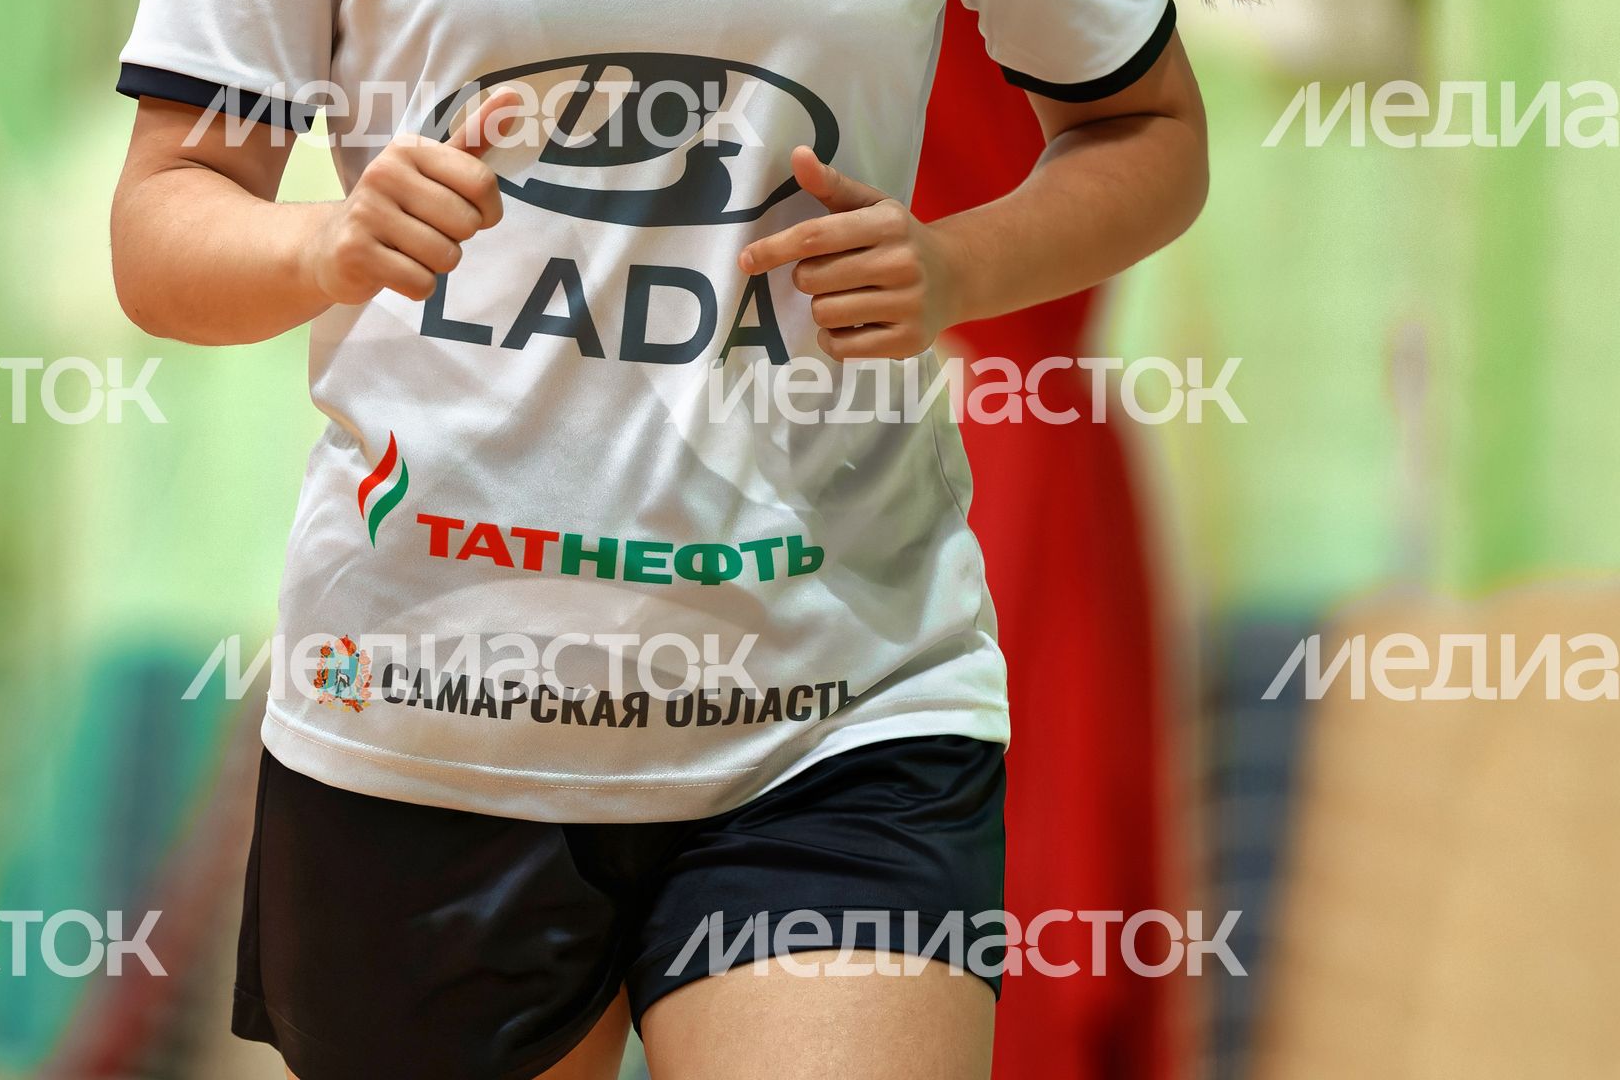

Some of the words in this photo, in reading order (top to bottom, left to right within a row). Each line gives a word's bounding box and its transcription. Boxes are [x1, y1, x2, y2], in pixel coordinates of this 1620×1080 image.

[420, 257, 790, 366] LADA
[416, 513, 825, 586] ТАТНЕФТЬ
[382, 662, 650, 729] САМАРСКАЯ
